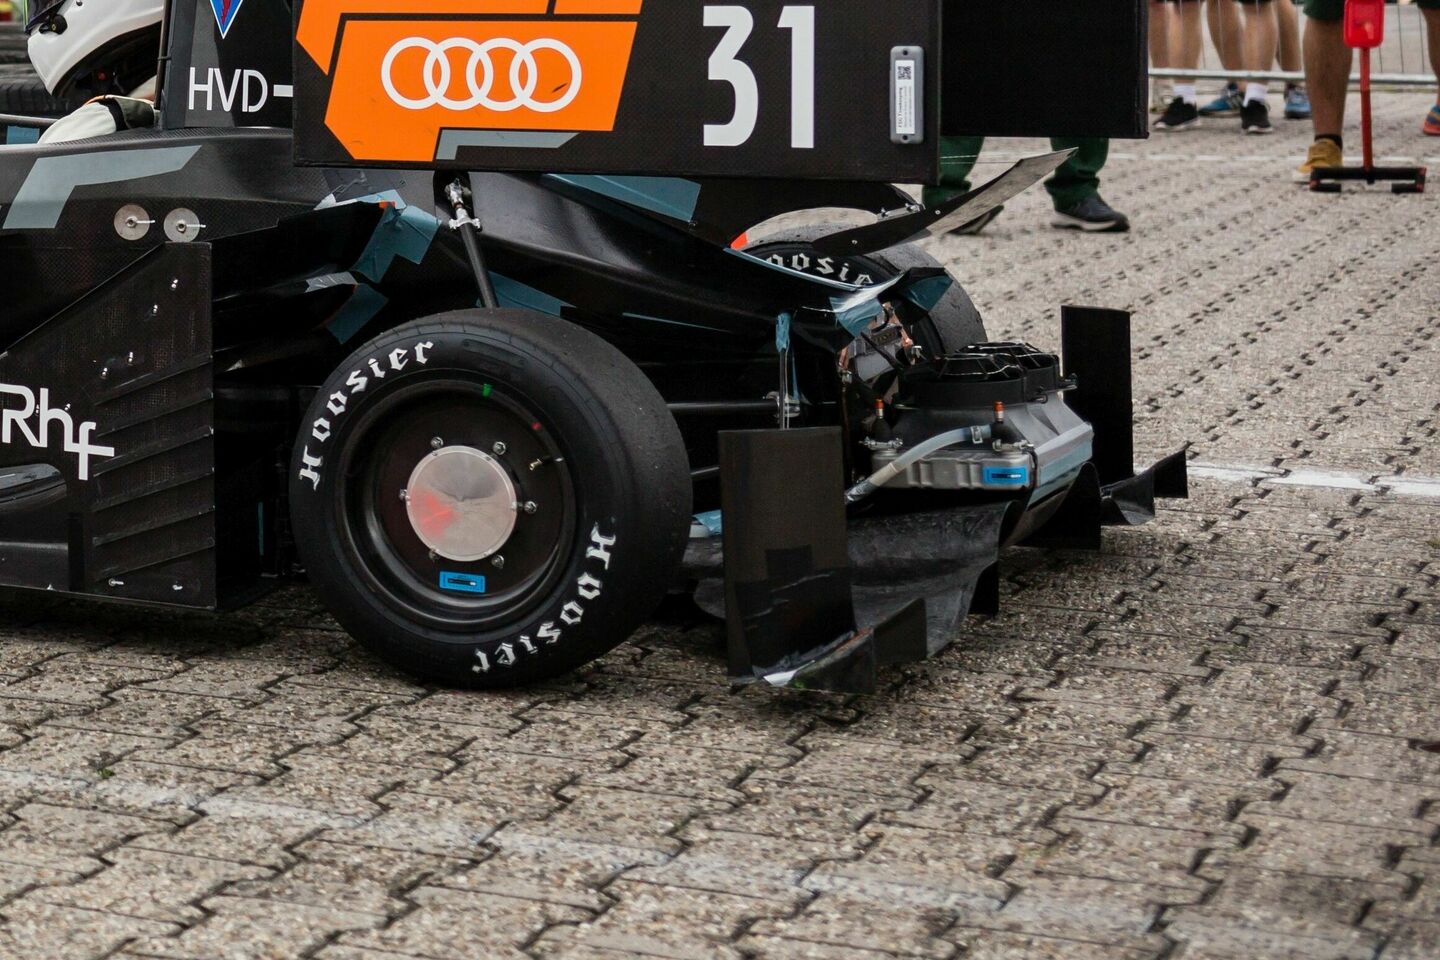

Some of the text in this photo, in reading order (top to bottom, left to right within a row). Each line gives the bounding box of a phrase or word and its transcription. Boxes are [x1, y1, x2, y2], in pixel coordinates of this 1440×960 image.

[703, 4, 815, 149] 31
[765, 253, 874, 286] oosie
[298, 341, 434, 491] Hoosier
[471, 521, 617, 673] Hoosier
